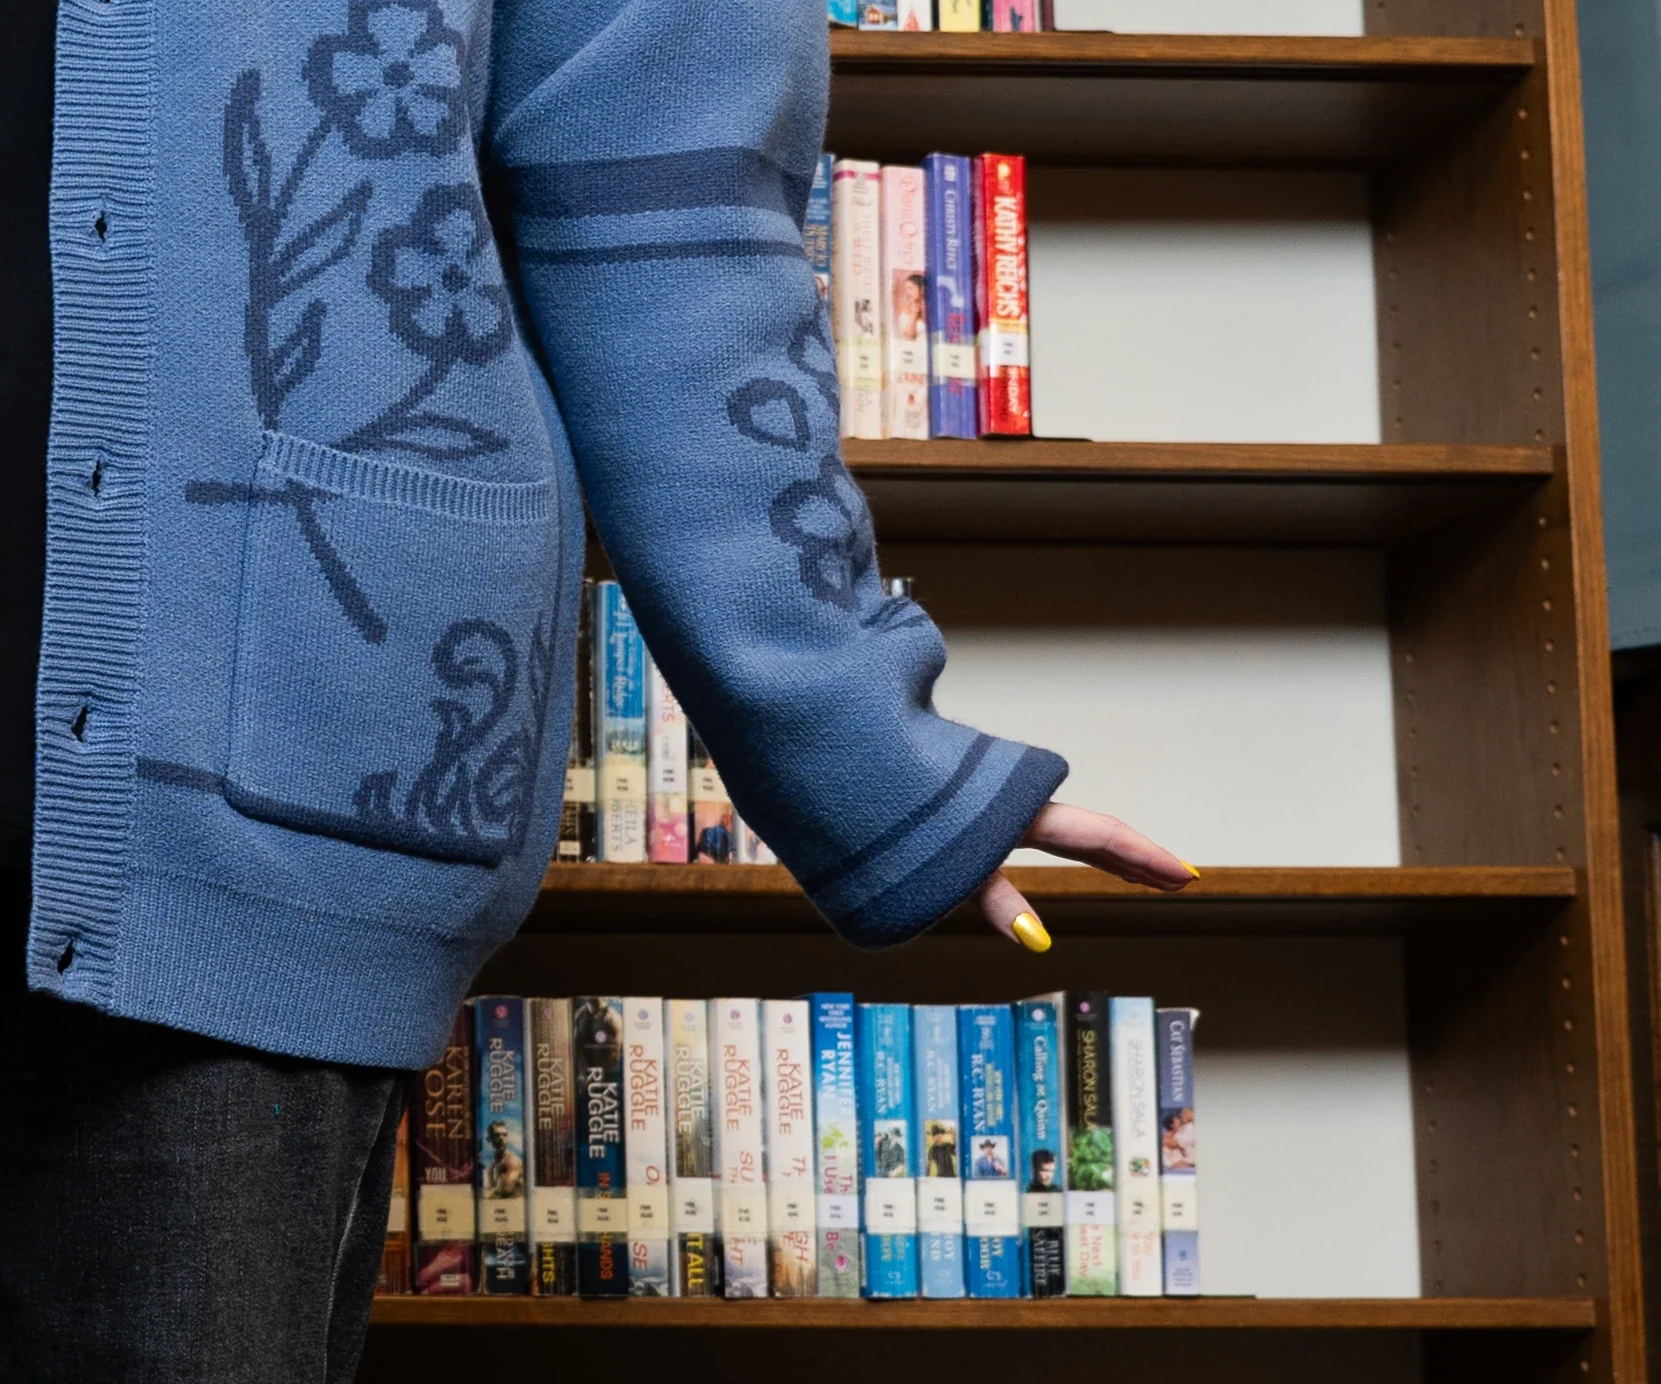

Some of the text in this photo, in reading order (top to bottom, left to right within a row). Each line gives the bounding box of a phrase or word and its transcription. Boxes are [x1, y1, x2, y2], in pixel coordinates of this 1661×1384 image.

[994, 197, 1019, 316] KATHY REICHS
[588, 1066, 603, 1158] RUGGLE
[602, 1082, 619, 1143] KATIE
[820, 1050, 835, 1098] RYAN
[836, 1032, 852, 1115] JENNIFER
[1034, 1035, 1047, 1140] Calling Quinn
[1081, 1030, 1096, 1131] SHARON SALA
